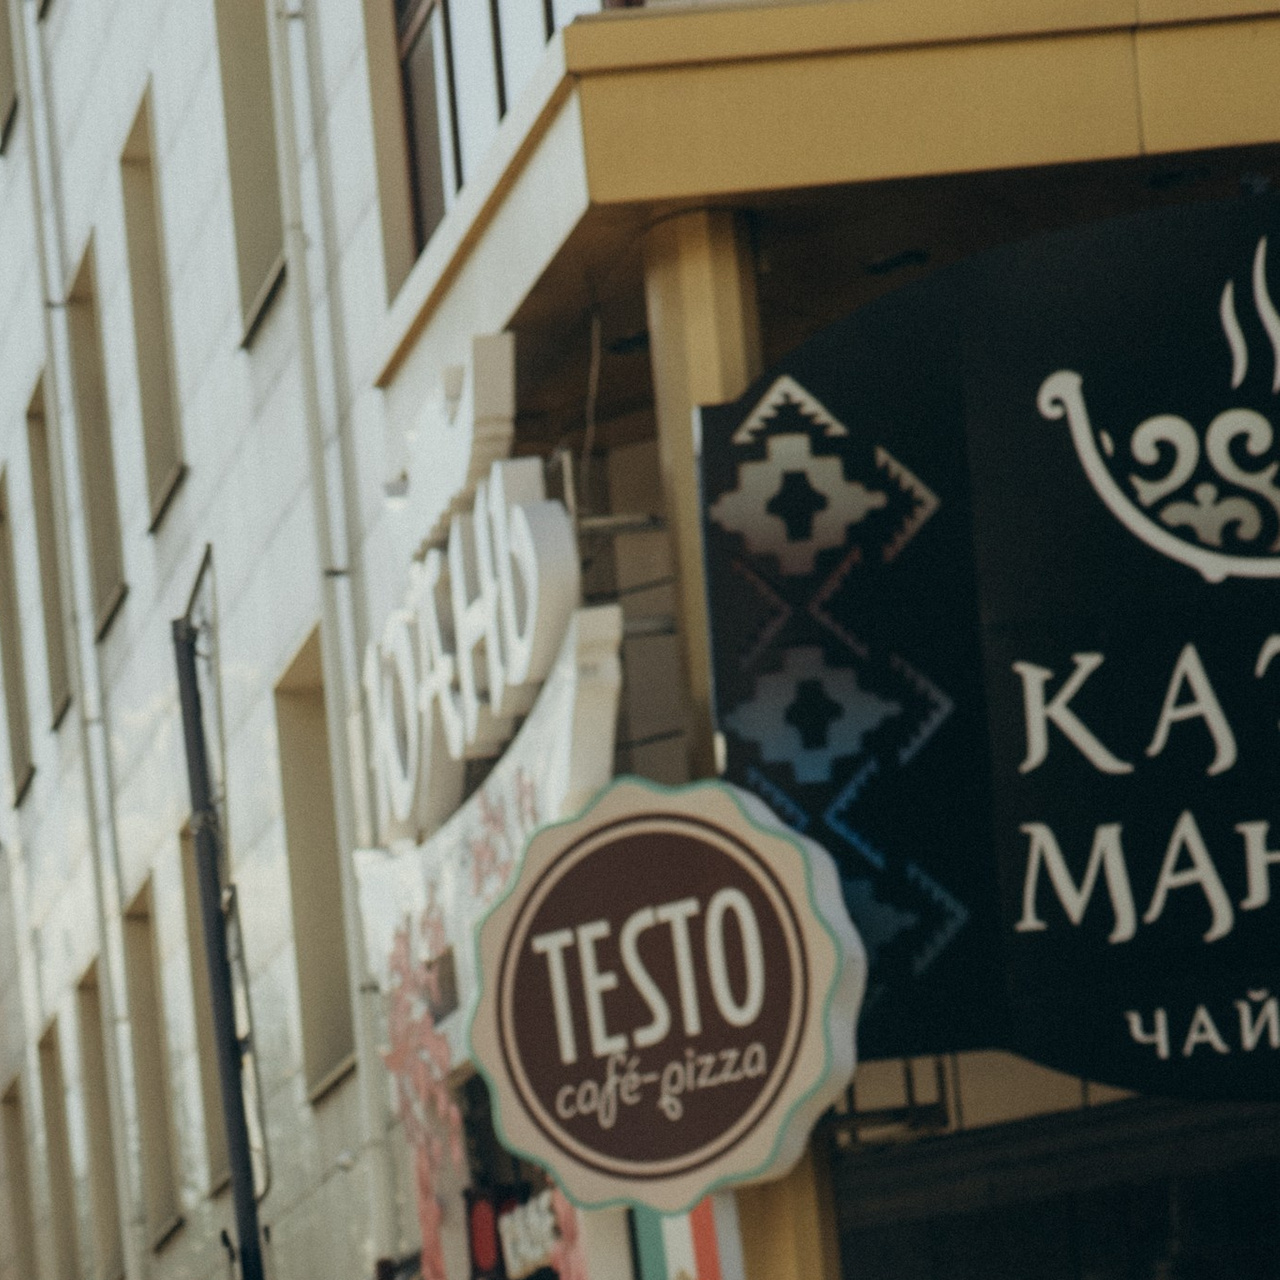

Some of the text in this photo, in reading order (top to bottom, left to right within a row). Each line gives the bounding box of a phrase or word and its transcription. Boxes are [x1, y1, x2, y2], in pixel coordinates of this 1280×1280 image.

[1012, 633, 1280, 776] КА
[531, 887, 766, 1066] TESTO
[555, 1041, 769, 1130] café-pizza
